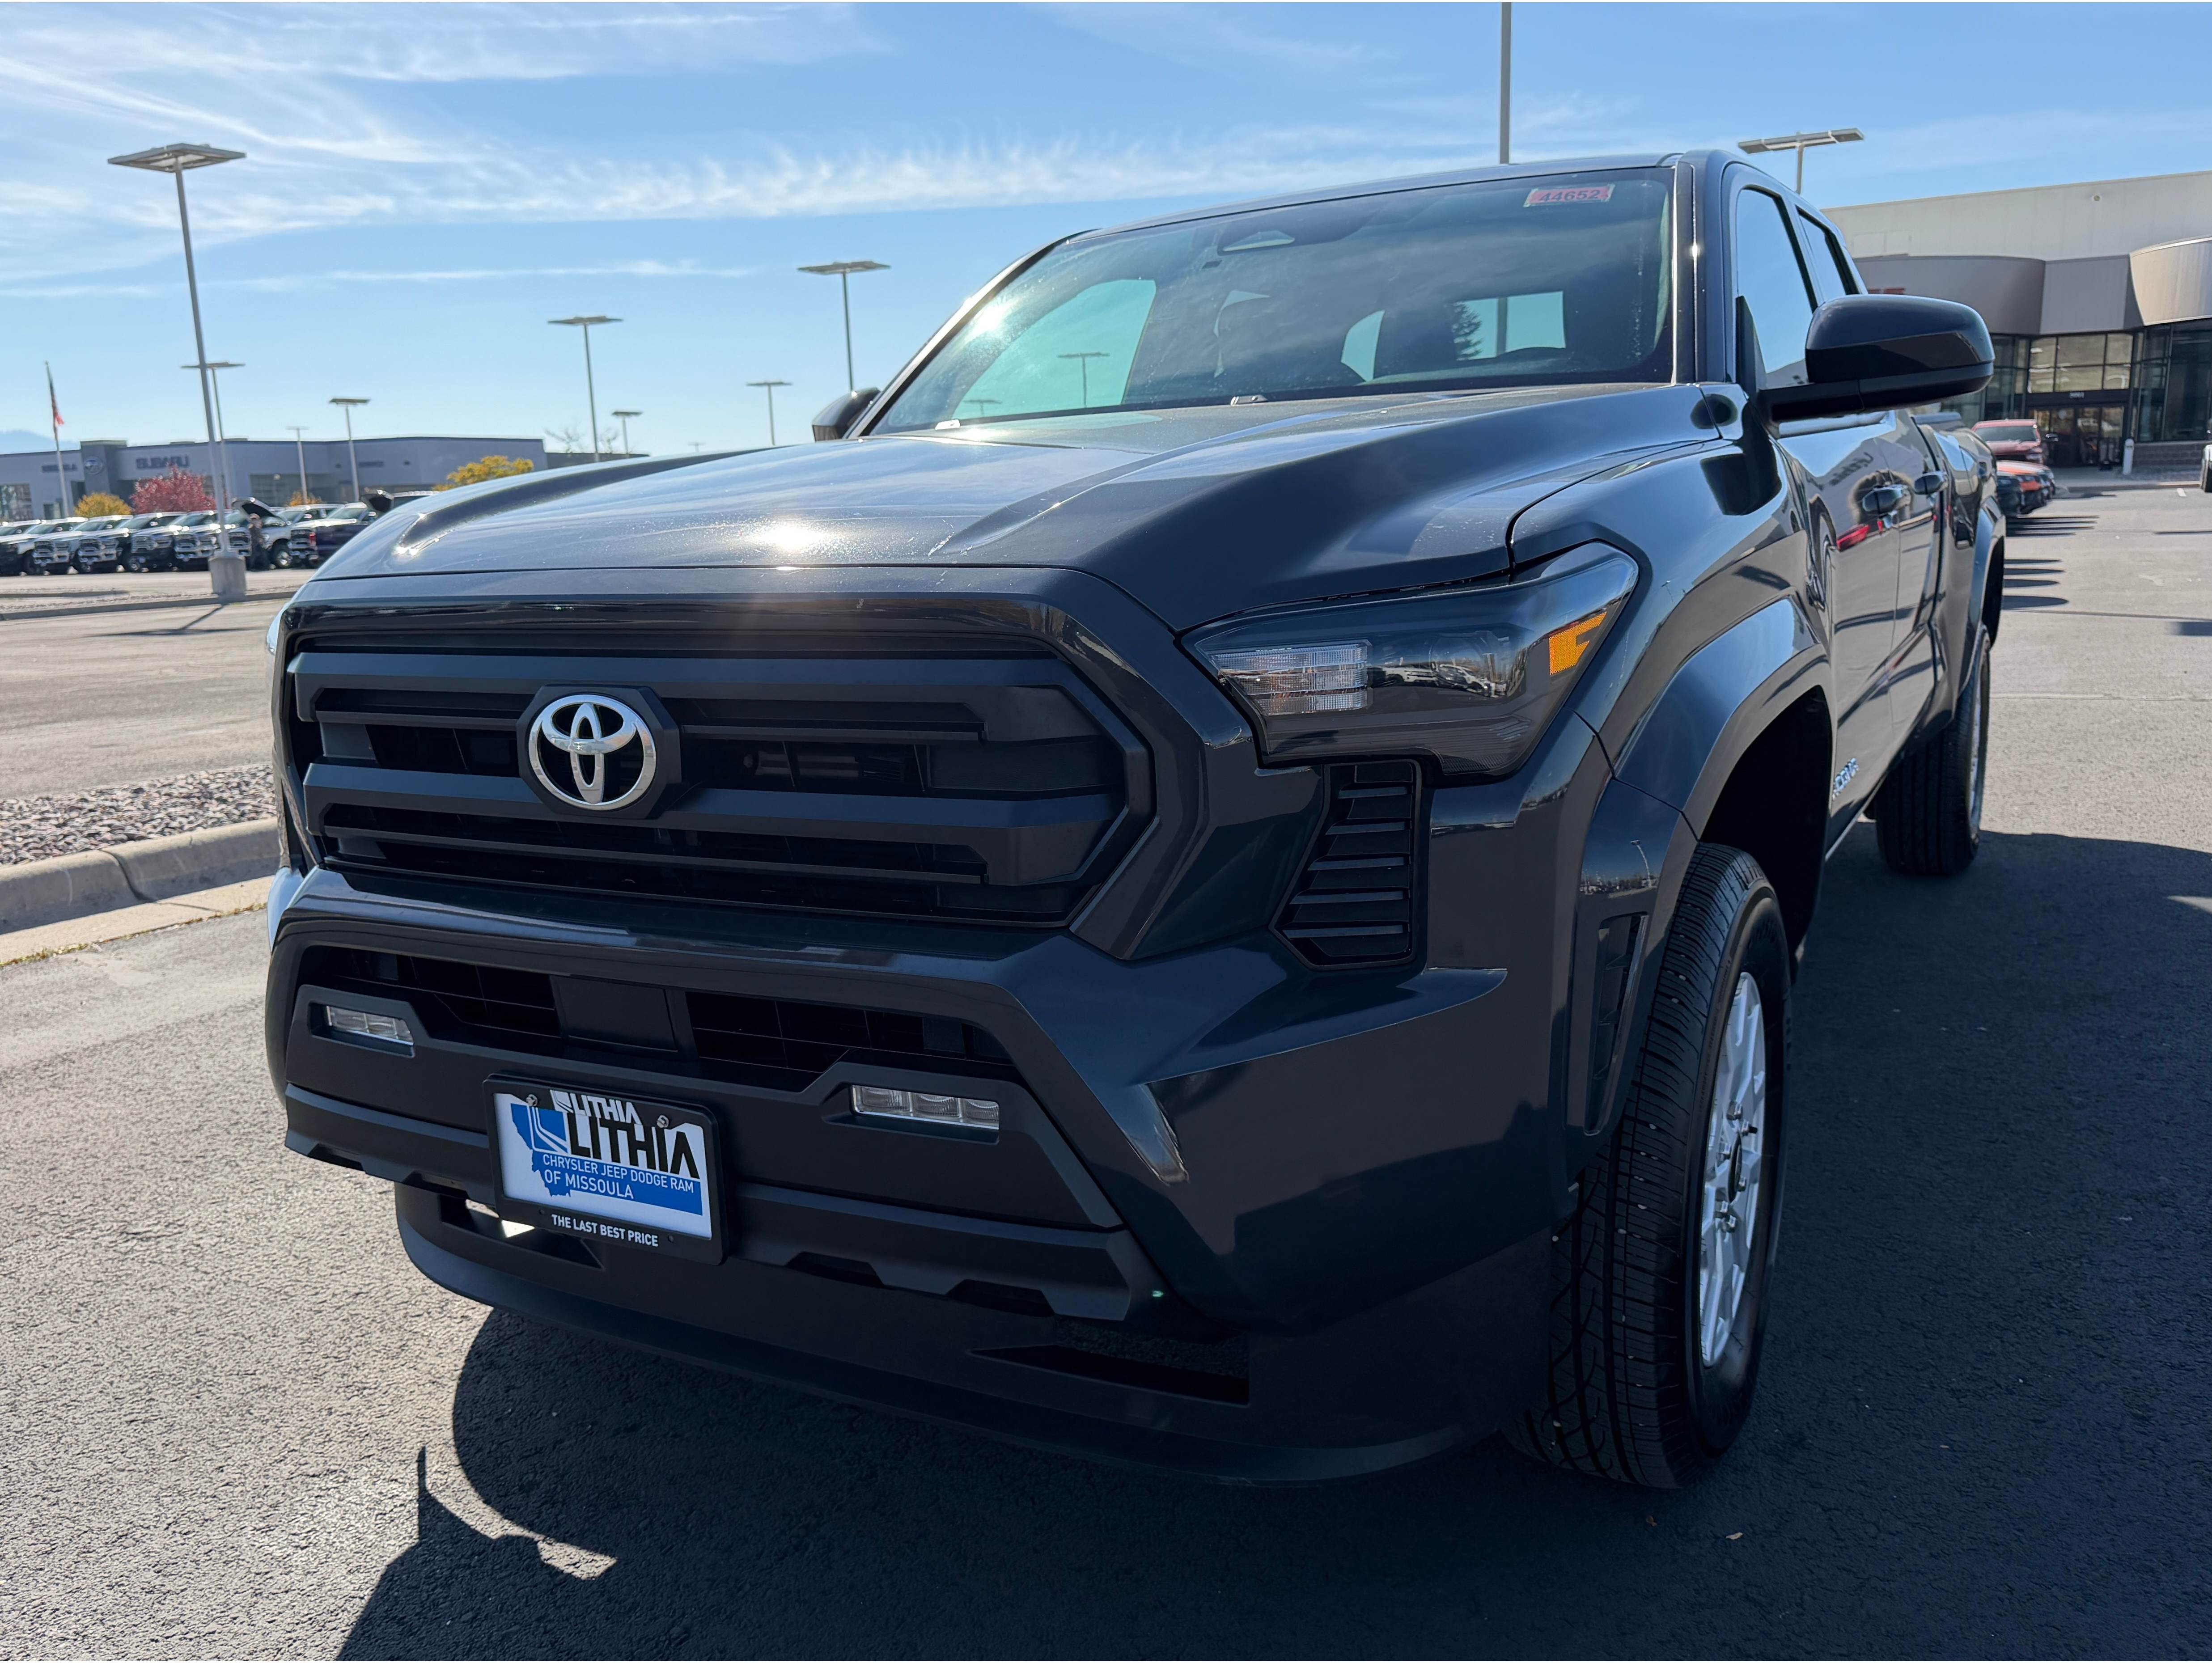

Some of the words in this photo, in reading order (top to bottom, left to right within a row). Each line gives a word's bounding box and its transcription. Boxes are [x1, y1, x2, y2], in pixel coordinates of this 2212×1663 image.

[1539, 189, 1601, 202] 44652
[571, 1093, 644, 1126] LITHIA
[567, 1113, 700, 1179] LITHIA
[543, 1154, 598, 1175] CHRYSLER
[601, 1165, 627, 1181] JEEP
[631, 1171, 668, 1189] DODGE
[671, 1178, 694, 1193] RAM
[544, 1169, 562, 1185] OF
[565, 1174, 634, 1199] MISSOULA
[551, 1214, 571, 1229] THE
[573, 1219, 598, 1234] LAST
[600, 1224, 626, 1240] BEST
[628, 1230, 659, 1247] PRICE
